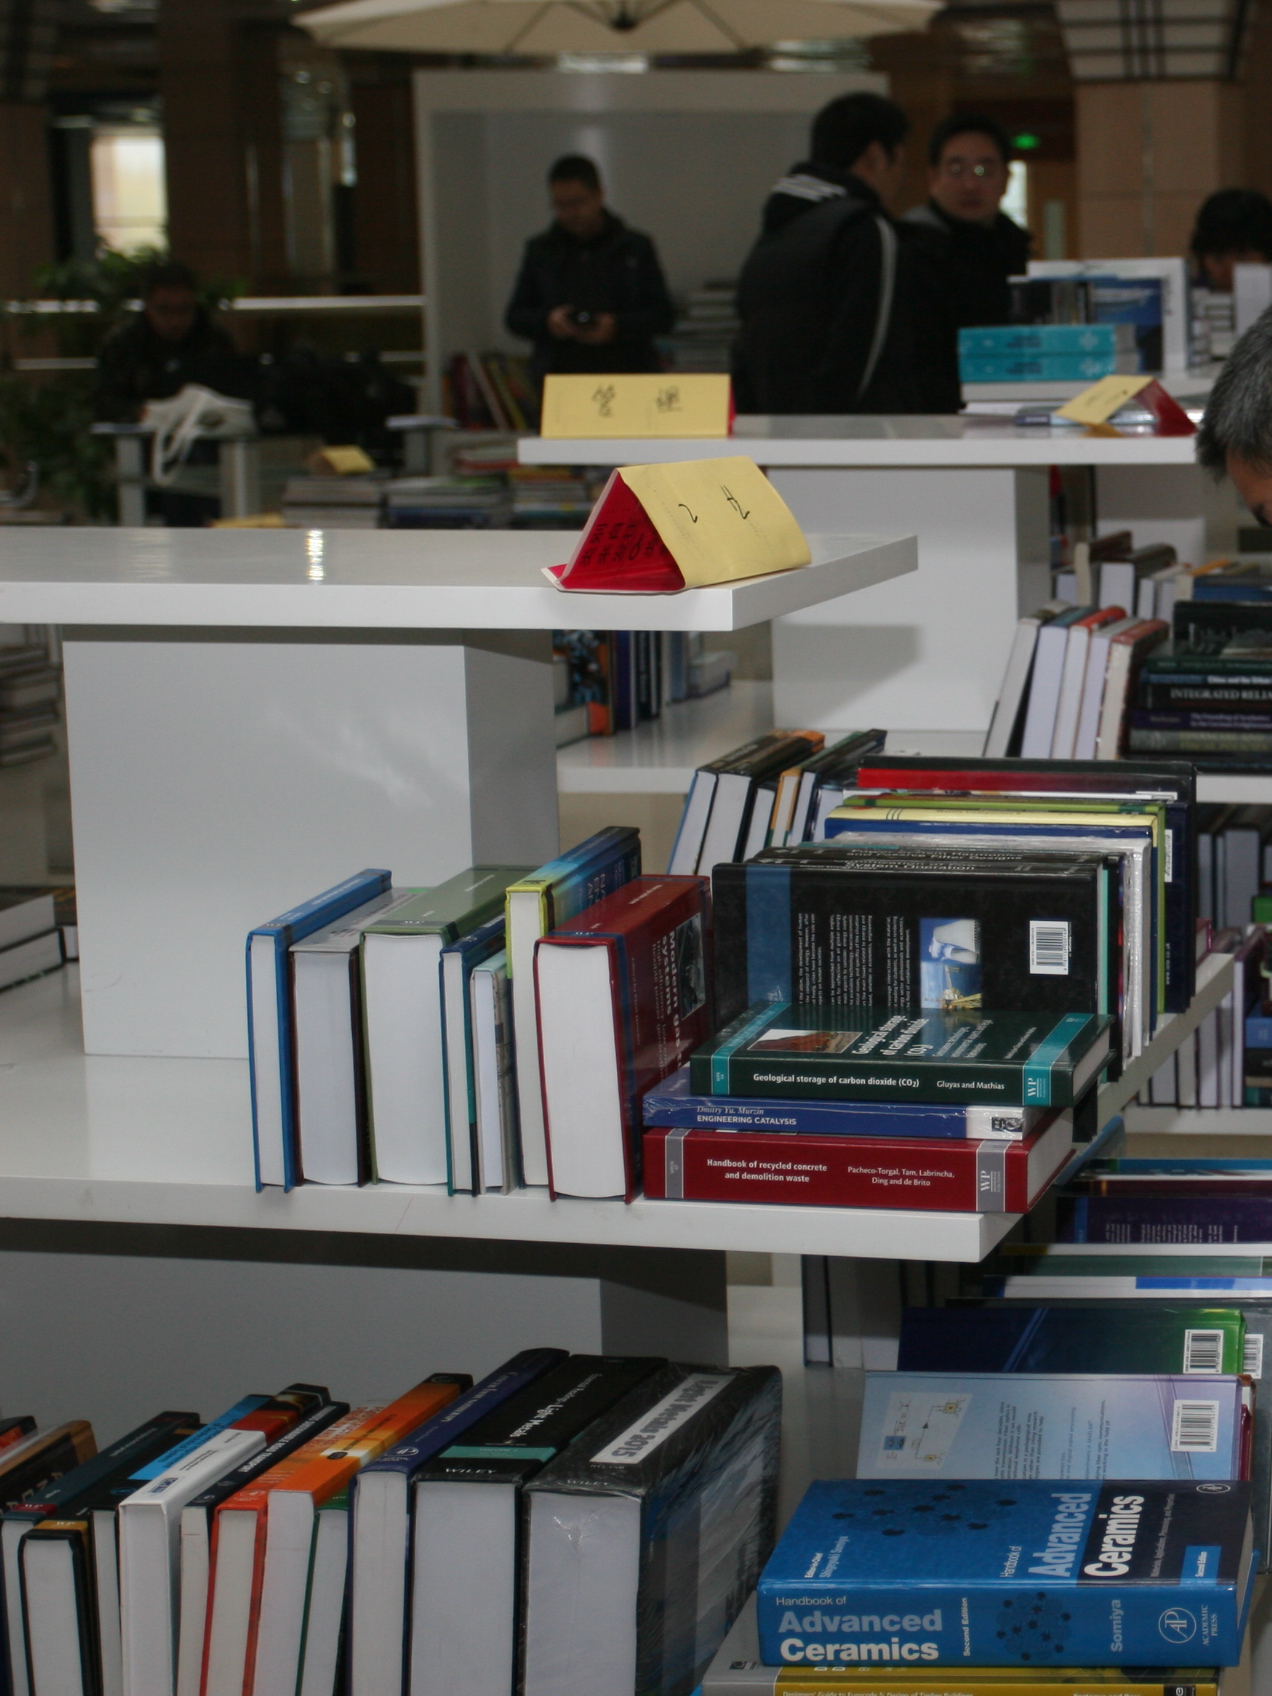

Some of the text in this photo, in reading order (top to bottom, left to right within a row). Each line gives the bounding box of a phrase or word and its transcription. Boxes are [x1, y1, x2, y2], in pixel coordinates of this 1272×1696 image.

[753, 1074, 794, 1086] Geological
[796, 1075, 826, 1086] storage
[828, 1075, 837, 1084] of
[839, 1076, 865, 1085] carbon
[867, 1077, 897, 1086] dioxide
[937, 1080, 956, 1090] Gluyas
[958, 1081, 974, 1089] and
[976, 1081, 1005, 1090] Mathias
[697, 1115, 796, 1125] ENGINEERING CATALYSIS
[707, 1158, 827, 1172] Handbook of recycled concrete
[901, 1168, 917, 1177] Tam,
[919, 1168, 955, 1179] Labrincha,
[725, 1171, 810, 1182] and demolition waste
[872, 1177, 888, 1186] Ding
[890, 1177, 902, 1185] and
[914, 1178, 931, 1186] Brito
[611, 1434, 656, 1458] 2015
[1028, 1492, 1092, 1578] Advanced
[1083, 1495, 1145, 1578] Ceramics
[776, 1595, 847, 1606] Handbook of
[778, 1609, 943, 1634] Advanced
[962, 1597, 970, 1656] Second Edition
[1201, 1603, 1209, 1646] ACADEMIC
[780, 1637, 939, 1662] Ceramics
